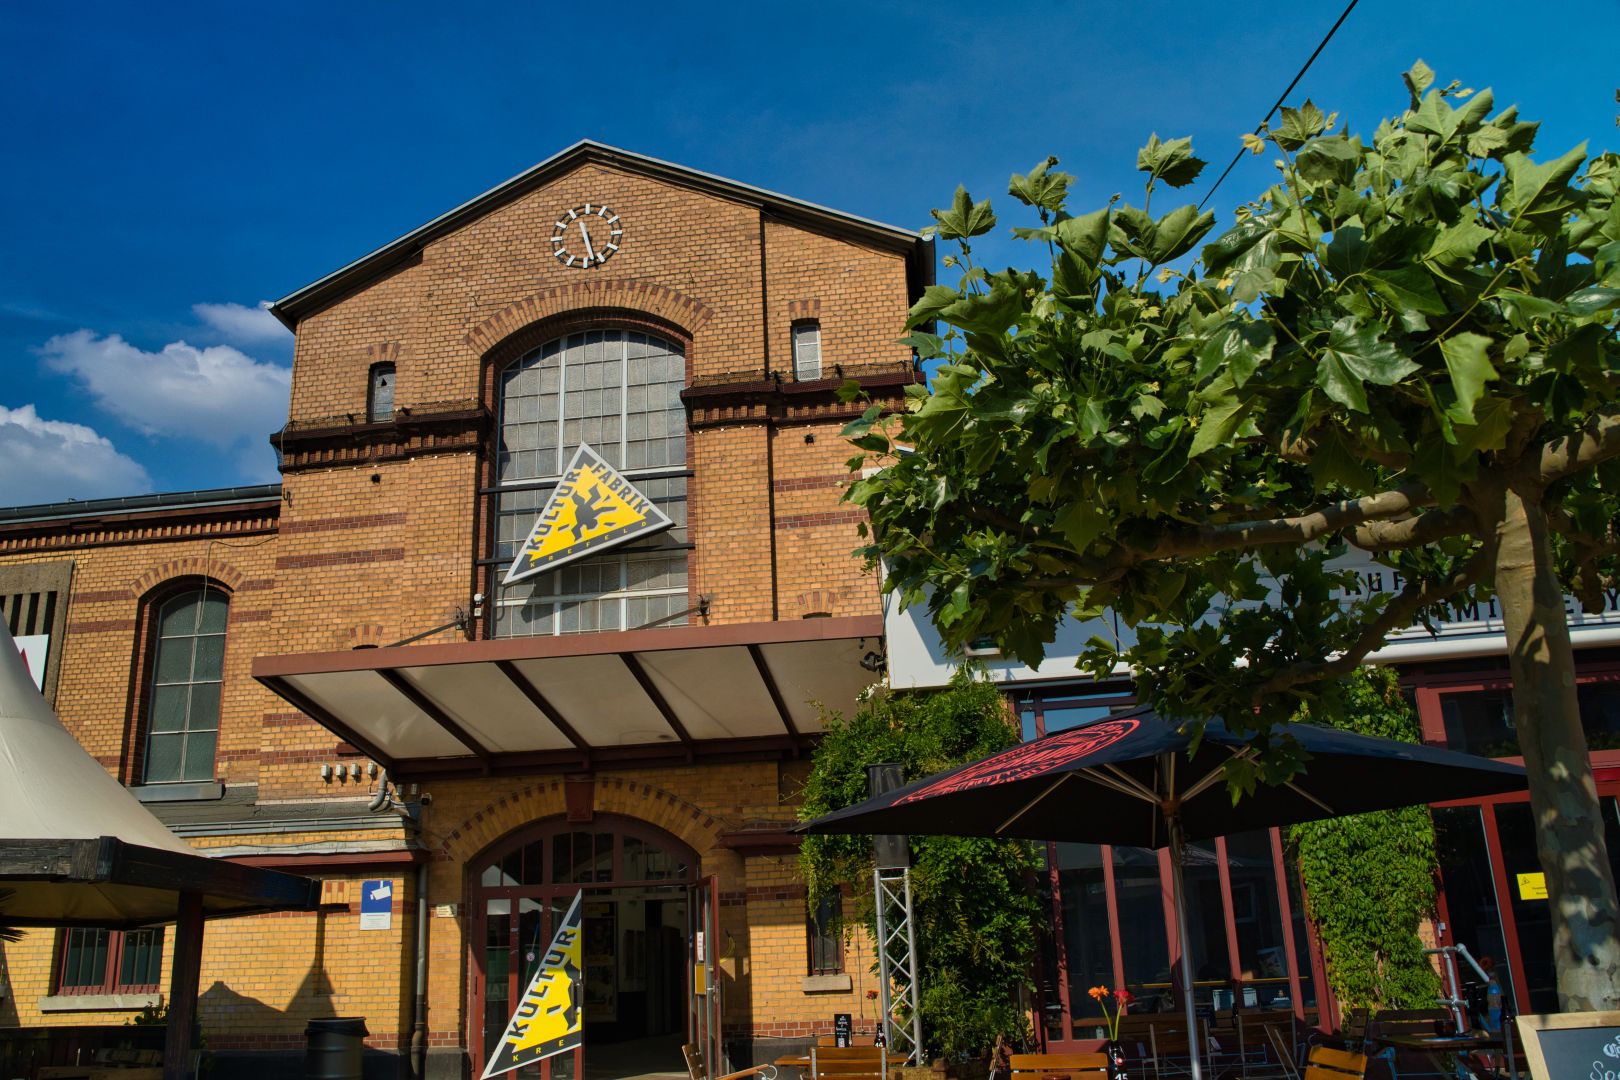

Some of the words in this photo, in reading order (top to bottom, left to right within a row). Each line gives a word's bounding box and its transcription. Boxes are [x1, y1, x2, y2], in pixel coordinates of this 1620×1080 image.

[526, 470, 580, 551] KULTUR
[591, 462, 650, 515] FABRIK
[529, 521, 647, 568] KREFELD
[507, 930, 576, 1039] KULTUR
[512, 1039, 564, 1062] KRE
